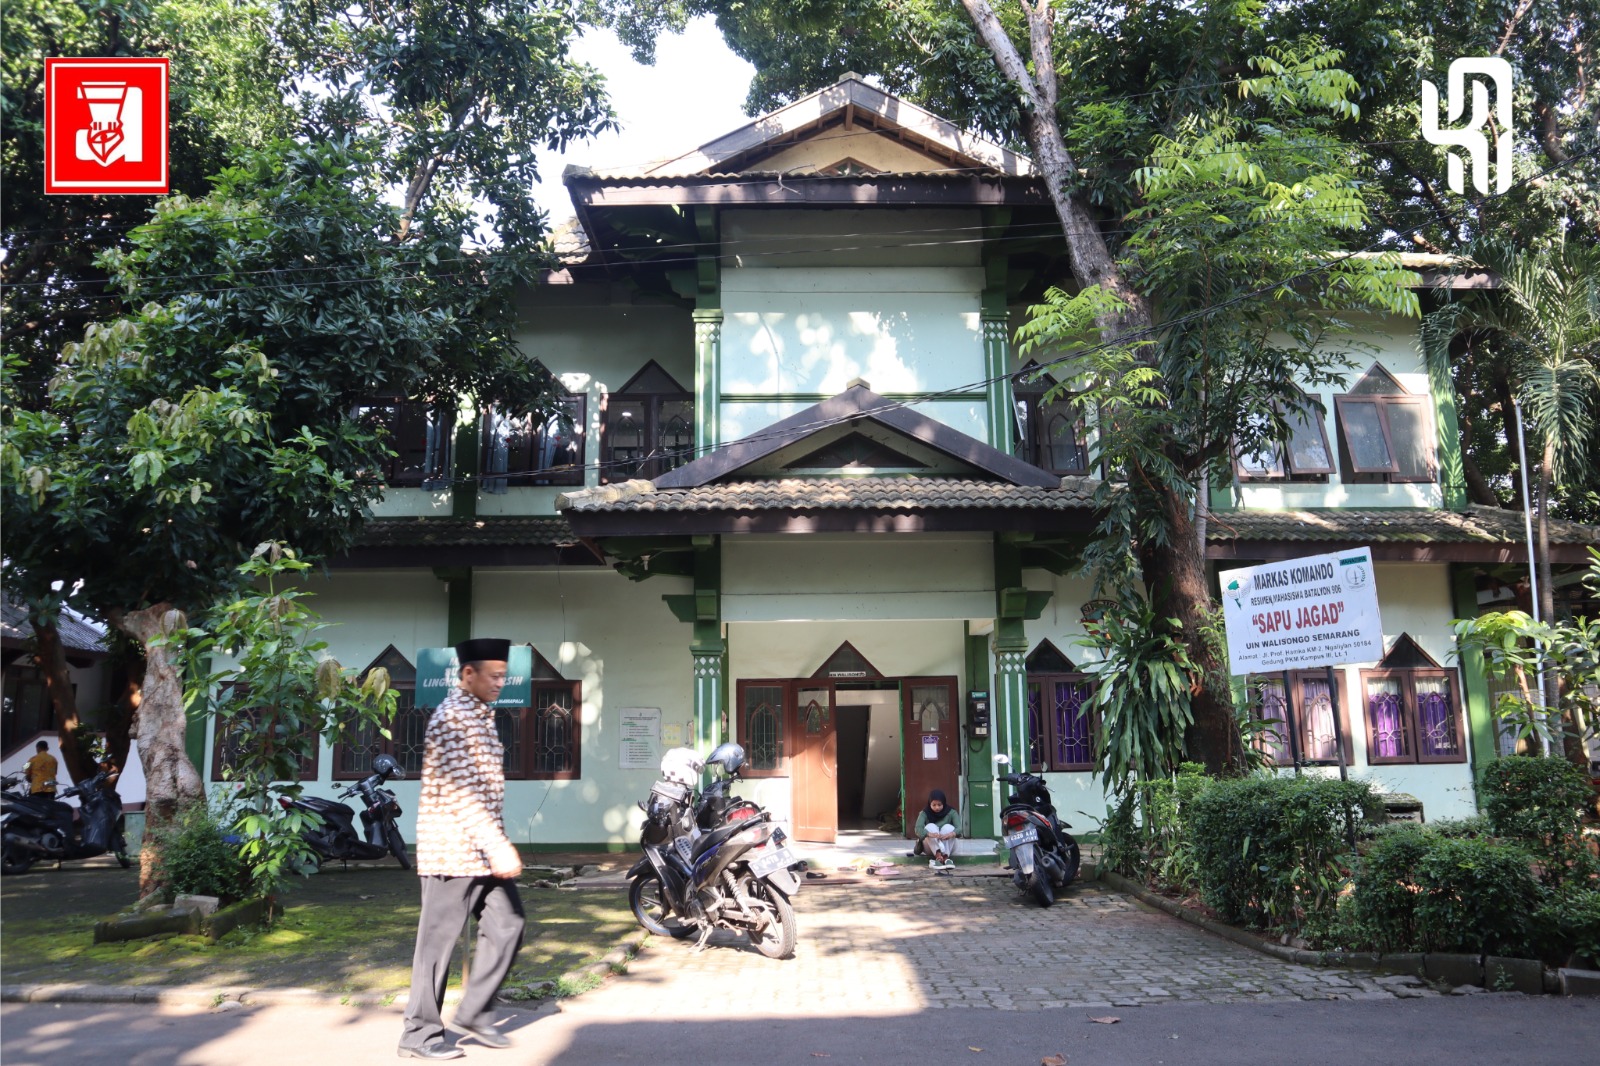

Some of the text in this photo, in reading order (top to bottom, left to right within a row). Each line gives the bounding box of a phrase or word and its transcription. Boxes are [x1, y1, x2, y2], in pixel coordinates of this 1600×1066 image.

[1254, 570, 1289, 590] MARKAS
[1290, 562, 1334, 584] KOMANDO
[1273, 590, 1304, 602] MAHASISWA
[1304, 586, 1331, 598] BATALYON
[1332, 584, 1342, 594] 906
[1246, 629, 1360, 650] UIN WALISONGO SEMARANG
[1238, 652, 1258, 660] Alamat
[1325, 642, 1352, 650] Ngaliyan
[1262, 656, 1284, 666] Gedung
[423, 677, 461, 687] LINGKU
